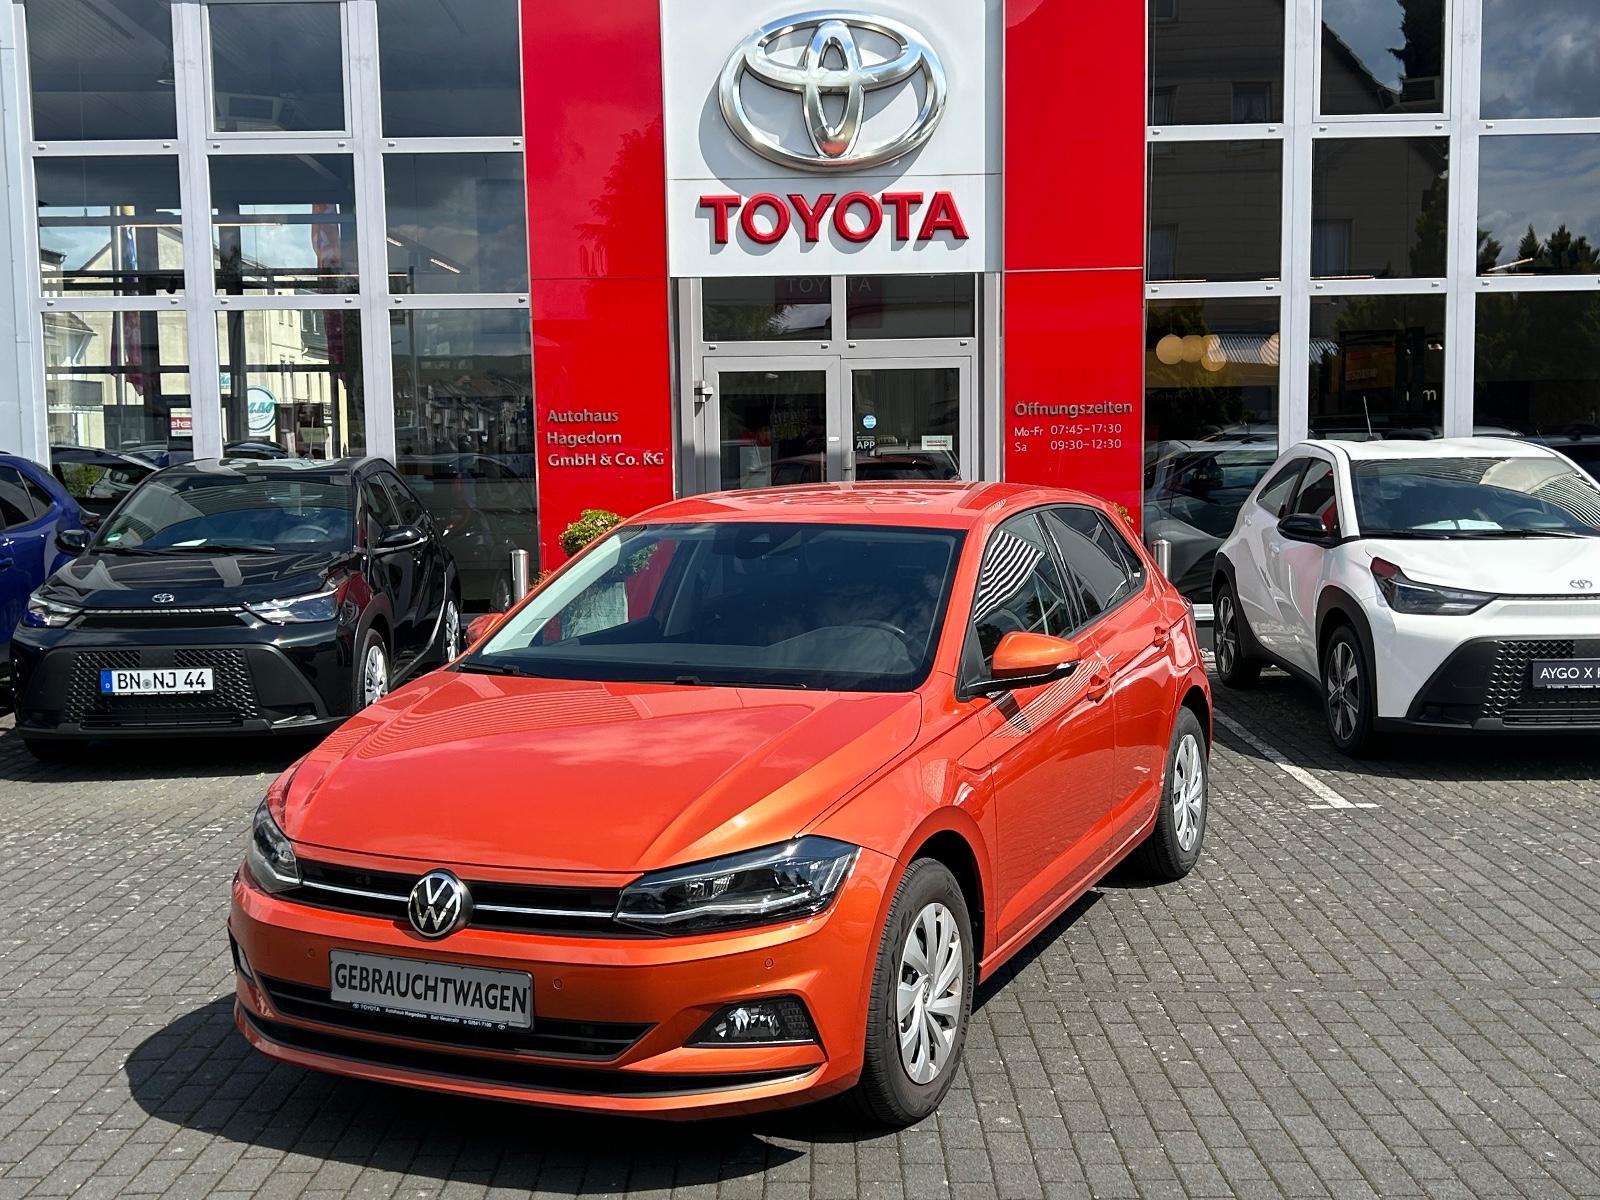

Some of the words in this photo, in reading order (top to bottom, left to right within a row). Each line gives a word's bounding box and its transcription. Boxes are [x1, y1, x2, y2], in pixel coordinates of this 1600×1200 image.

[700, 191, 969, 244] TOYOTA
[785, 277, 872, 293] TOYTA
[547, 409, 619, 422] Autohaus
[1015, 400, 1133, 418] Öffnungszeiten
[547, 430, 622, 448] Hagedorn
[1014, 426, 1044, 437] Mo-Fr
[856, 441, 876, 449] APP
[1015, 442, 1027, 452] Sa
[548, 453, 596, 466] GmbH
[600, 453, 612, 466] &
[615, 453, 640, 466] Co.
[643, 451, 664, 466] KG
[118, 672, 141, 689] BN
[153, 672, 177, 689] NJ
[184, 671, 206, 688] 44
[1540, 667, 1580, 679] AYGO
[1584, 667, 1593, 679] X
[335, 963, 527, 1014] GEBRAUCHTWAGEN
